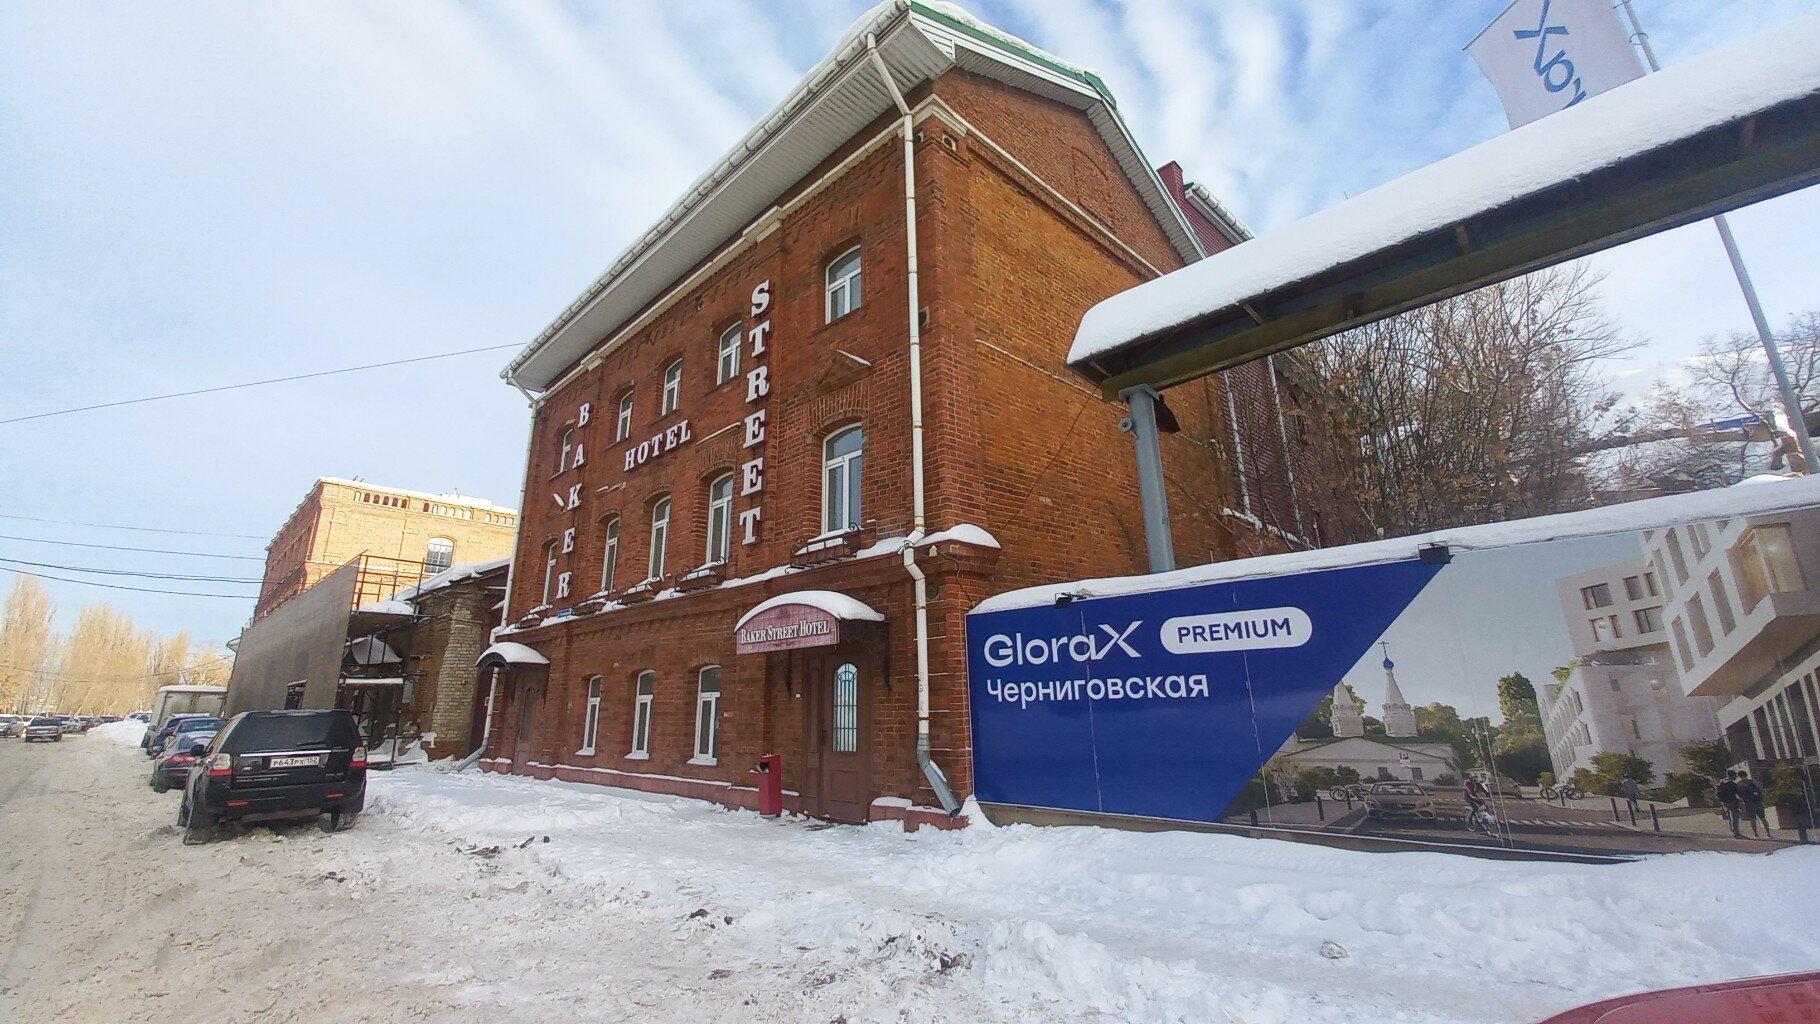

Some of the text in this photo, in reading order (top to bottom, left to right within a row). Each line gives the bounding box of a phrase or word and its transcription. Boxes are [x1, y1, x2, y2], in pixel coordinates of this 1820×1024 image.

[739, 280, 770, 546] STREET
[624, 419, 691, 472] HOTEL
[557, 402, 590, 599] BAKER
[741, 620, 830, 644] BAKER STREET HOTEL
[984, 617, 1292, 667] GloraX PREMIUM
[987, 674, 1209, 709] Черниговская
